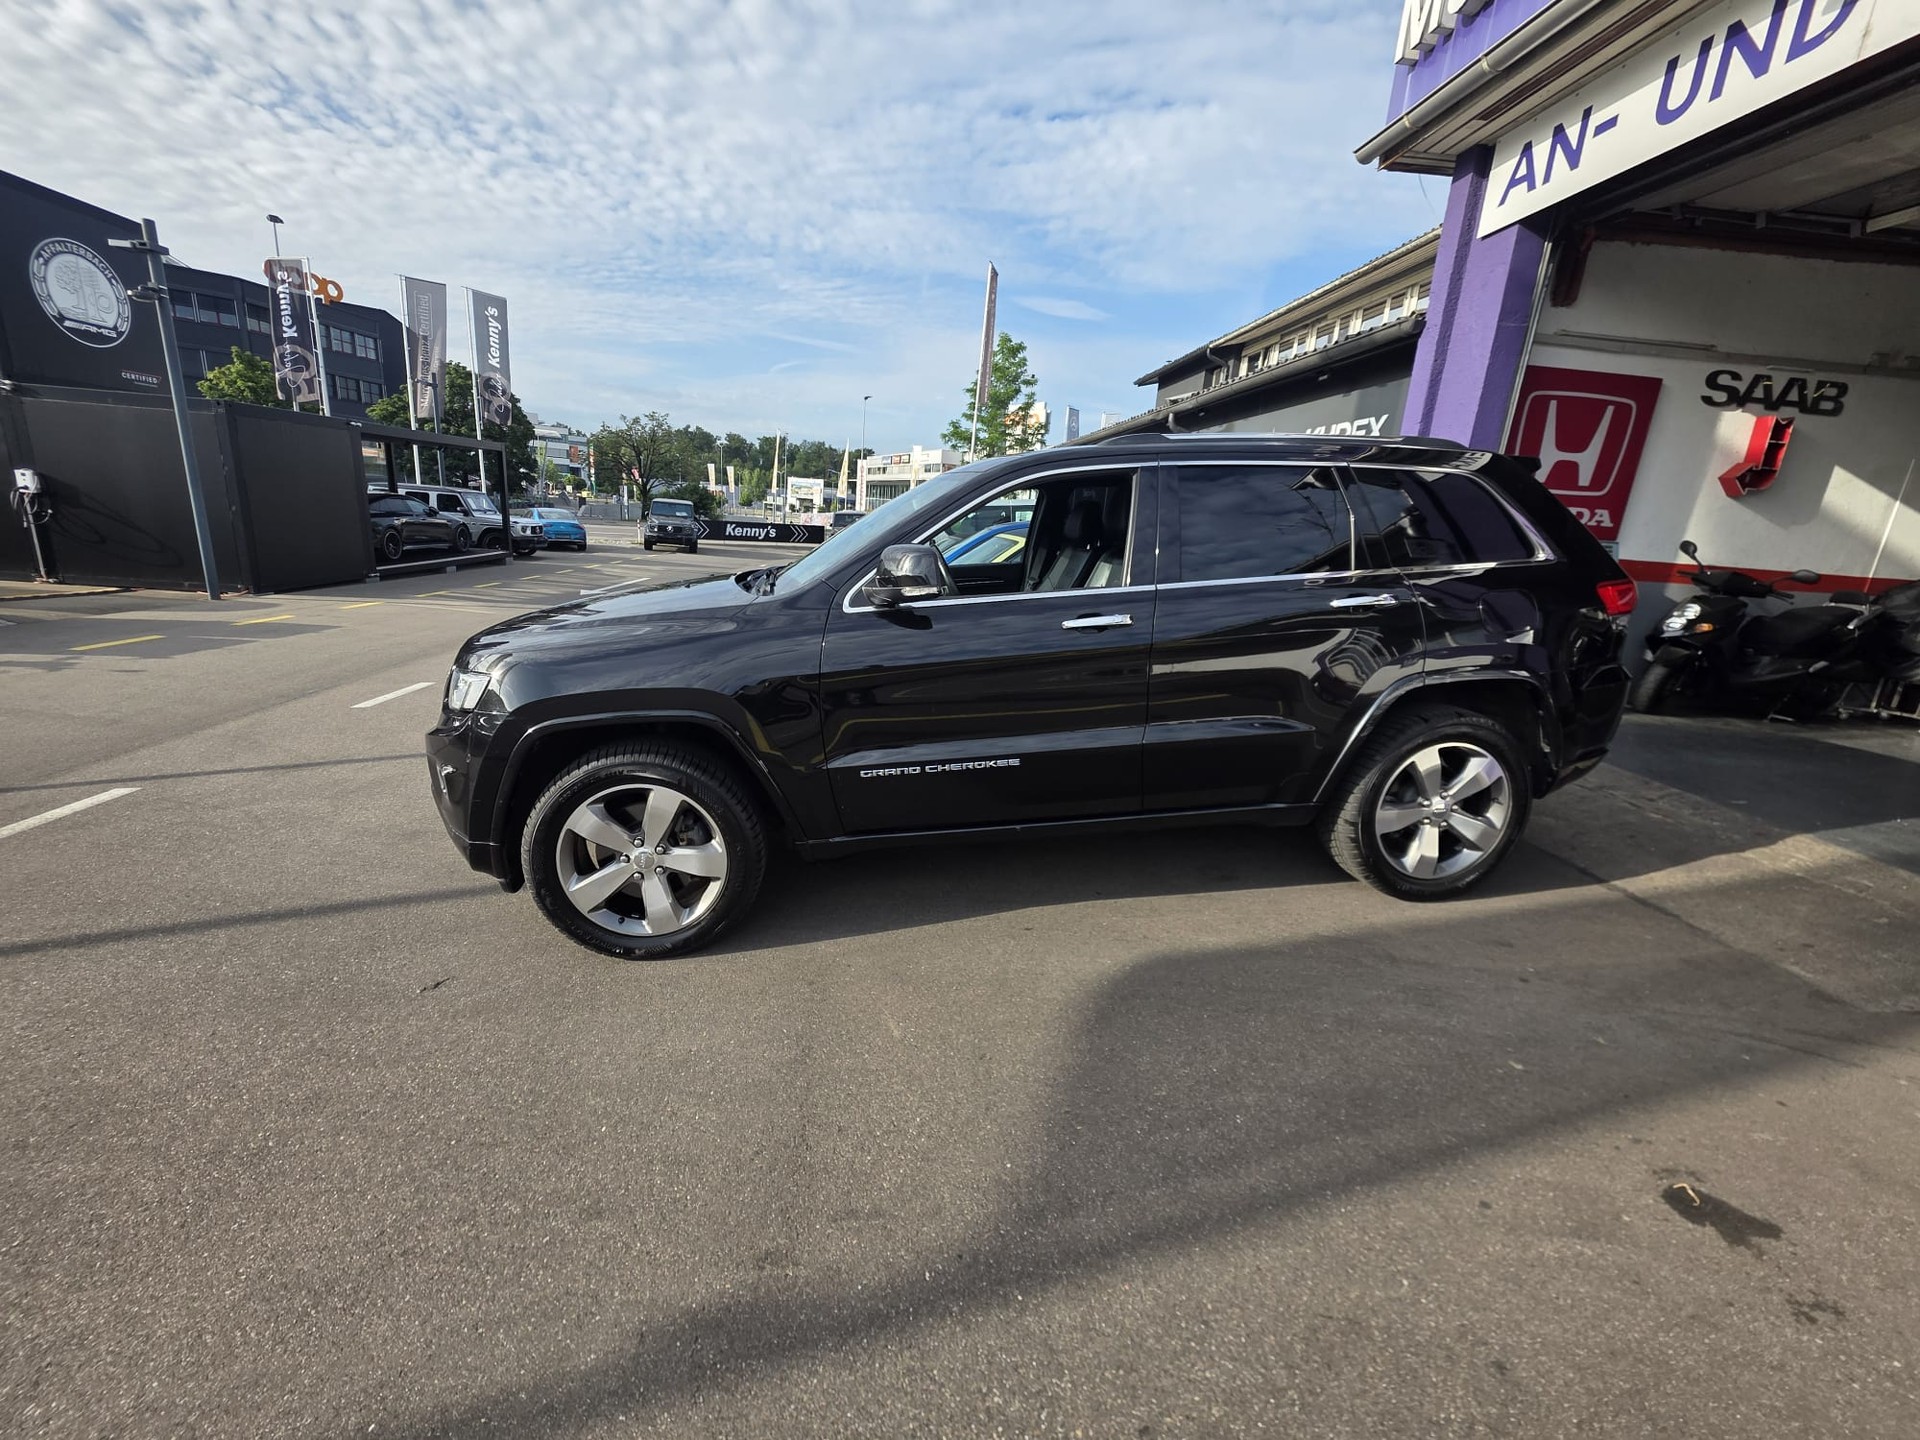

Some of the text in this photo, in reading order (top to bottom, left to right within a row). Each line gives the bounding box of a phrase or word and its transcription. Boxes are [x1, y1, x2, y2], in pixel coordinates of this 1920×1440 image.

[1498, 105, 1620, 207] AN-
[41, 241, 113, 279] AFFALTERBACH
[484, 305, 502, 369] Kenny's
[121, 371, 158, 384] CERTIFIED
[1700, 370, 1849, 417] SAAB
[725, 523, 777, 540] Kenny's
[1567, 507, 1614, 528] DA
[860, 758, 1021, 778] GRAND CHEROKEE
